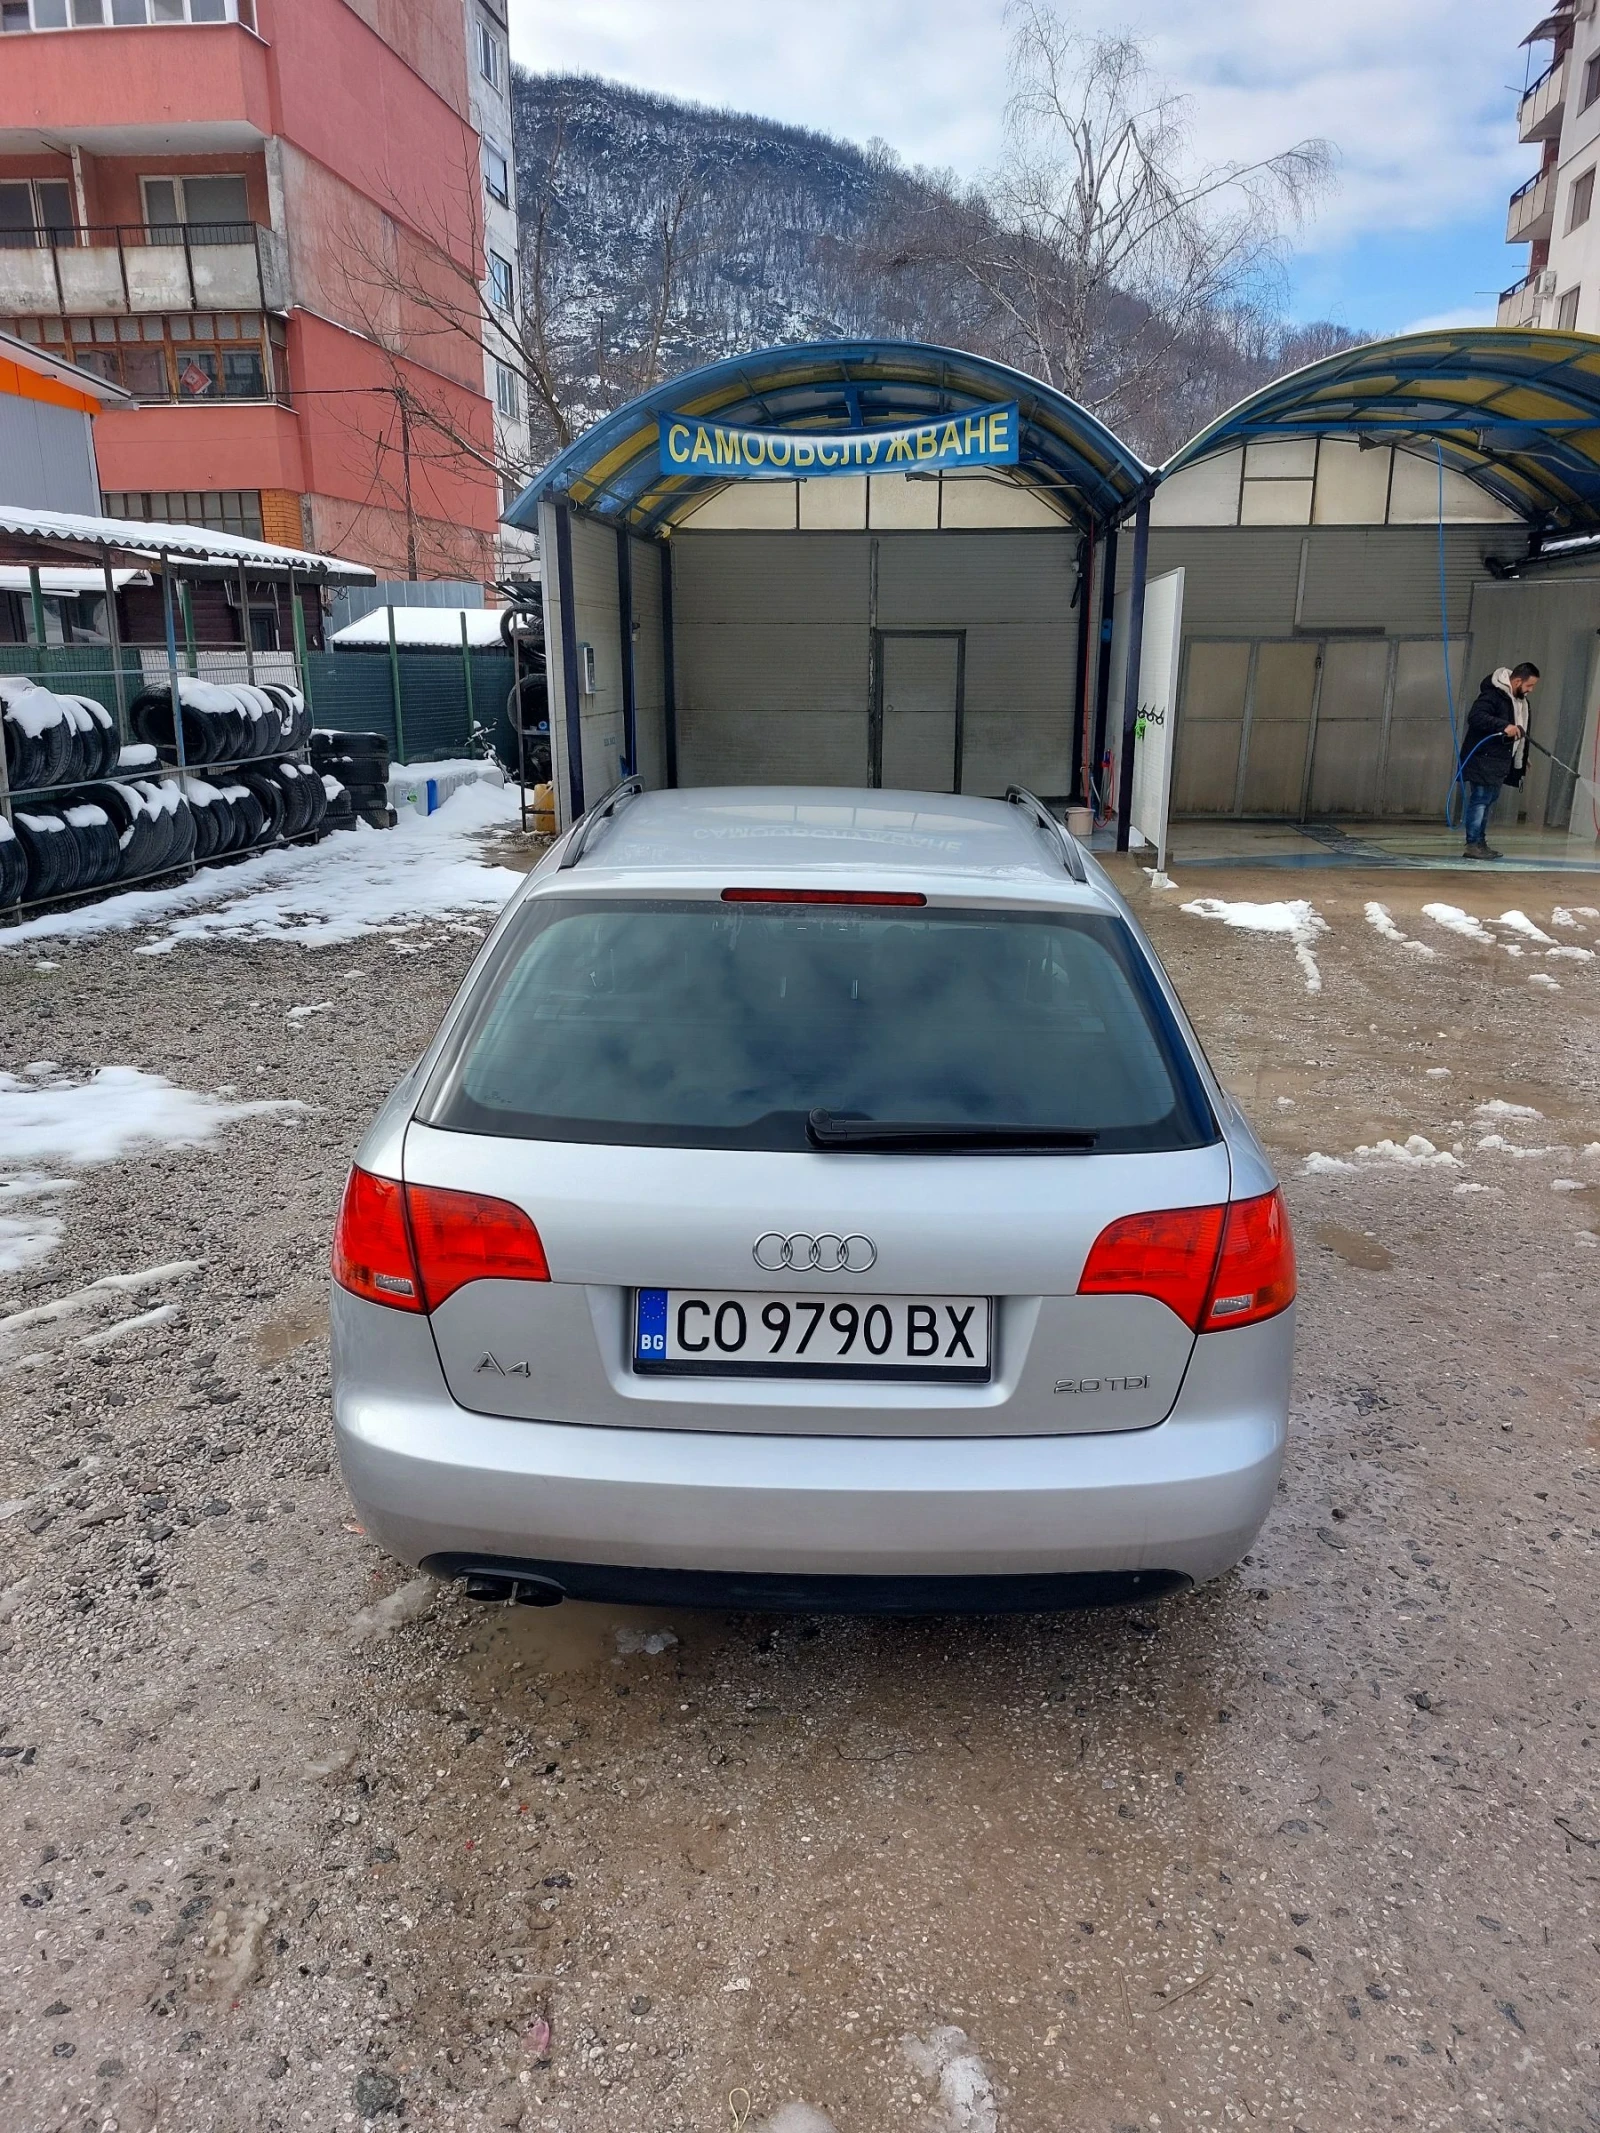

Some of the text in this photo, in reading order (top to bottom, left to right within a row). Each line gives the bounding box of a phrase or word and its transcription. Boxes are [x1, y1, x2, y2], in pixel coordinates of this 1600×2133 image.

[668, 413, 1009, 467] САМООБСЛУЖВАНЕ
[641, 1334, 664, 1350] BG
[761, 1302, 893, 1355] 9790
[906, 1305, 975, 1358] BX
[473, 1351, 531, 1378] A4
